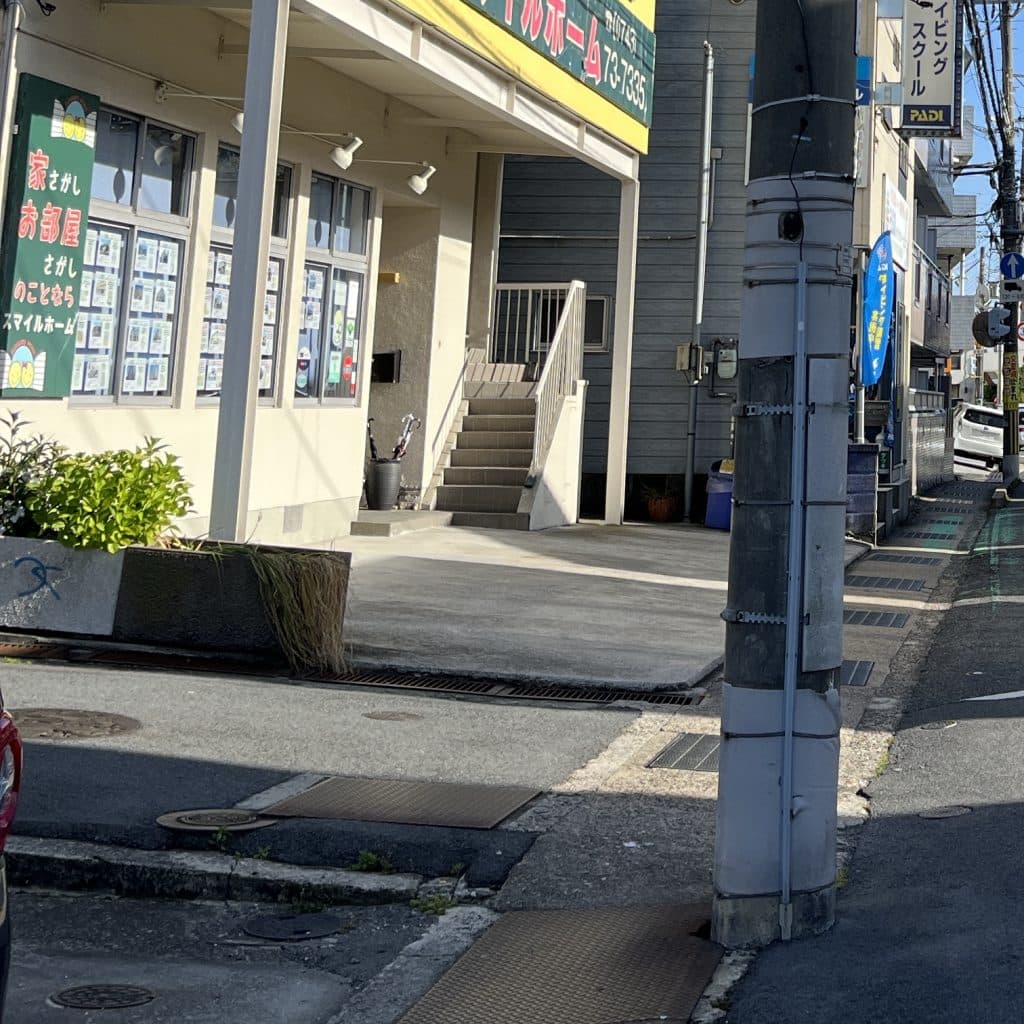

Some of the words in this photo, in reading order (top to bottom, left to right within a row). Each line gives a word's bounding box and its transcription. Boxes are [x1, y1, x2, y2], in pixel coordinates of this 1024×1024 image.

[603, 44, 648, 112] 73-7335
[910, 22, 926, 97] スクール
[910, 108, 944, 122] PADI
[27, 148, 81, 196] 家さがし
[17, 198, 82, 248] お部屋
[43, 253, 78, 278] さがし
[13, 280, 75, 309] のことなら
[3, 312, 79, 336] スマイルホーム
